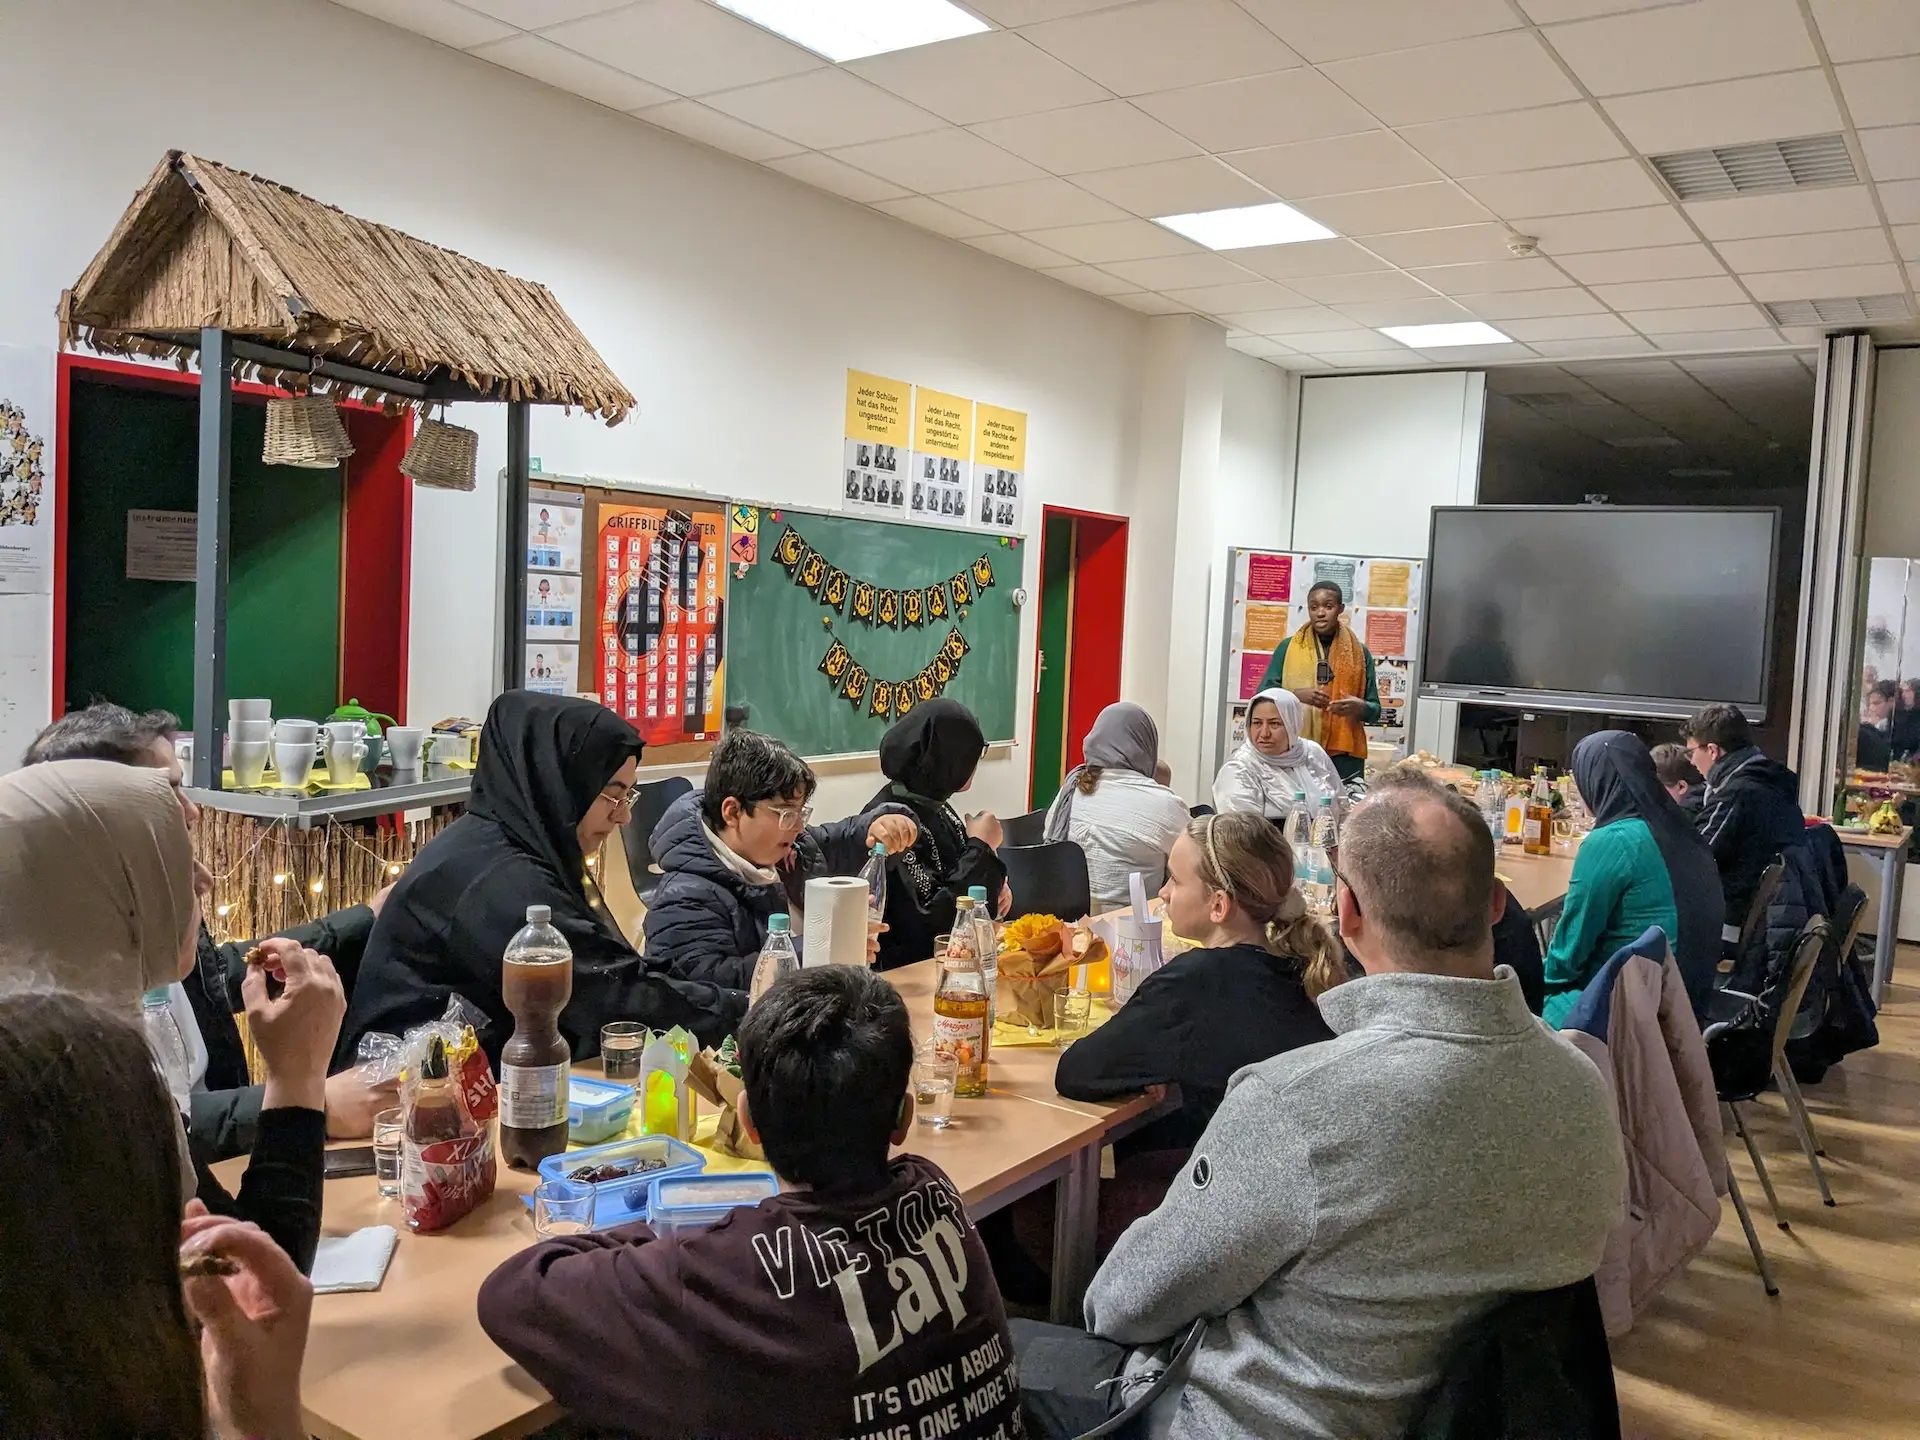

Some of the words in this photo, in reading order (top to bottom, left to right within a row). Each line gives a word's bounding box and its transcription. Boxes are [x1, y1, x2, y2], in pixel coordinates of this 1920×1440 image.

[857, 386, 875, 397] Jeder
[876, 390, 898, 403] Schüler
[856, 396, 867, 407] hat
[868, 400, 879, 410] das
[880, 402, 899, 415] Recht,
[927, 404, 942, 415] Jeder
[943, 408, 960, 420] Lehrer
[859, 410, 888, 422] ungestört
[889, 416, 896, 425] zu
[924, 414, 933, 424] hat
[934, 417, 944, 427] das
[945, 419, 962, 432] Recht,
[986, 419, 1001, 429] Jeder
[1001, 424, 1015, 432] muss
[866, 422, 888, 434] lernen!
[926, 428, 952, 439] ungestört
[952, 433, 960, 441] zu
[983, 429, 991, 437] die
[991, 430, 1008, 441] Rechte
[1009, 434, 1018, 443] der
[925, 438, 959, 451] unterrichten!
[990, 441, 1010, 451] anderen
[983, 450, 1015, 462] respektieren!
[808, 562, 968, 613] RAMADAN
[829, 640, 964, 703] MUBARAK
[832, 1219, 968, 1375] Lap
[853, 1385, 902, 1424] IT'S
[907, 1363, 954, 1407] ONLY
[961, 1333, 1005, 1383] ABOUT
[919, 1402, 962, 1440] ONE
[963, 1376, 1007, 1423] MORE
